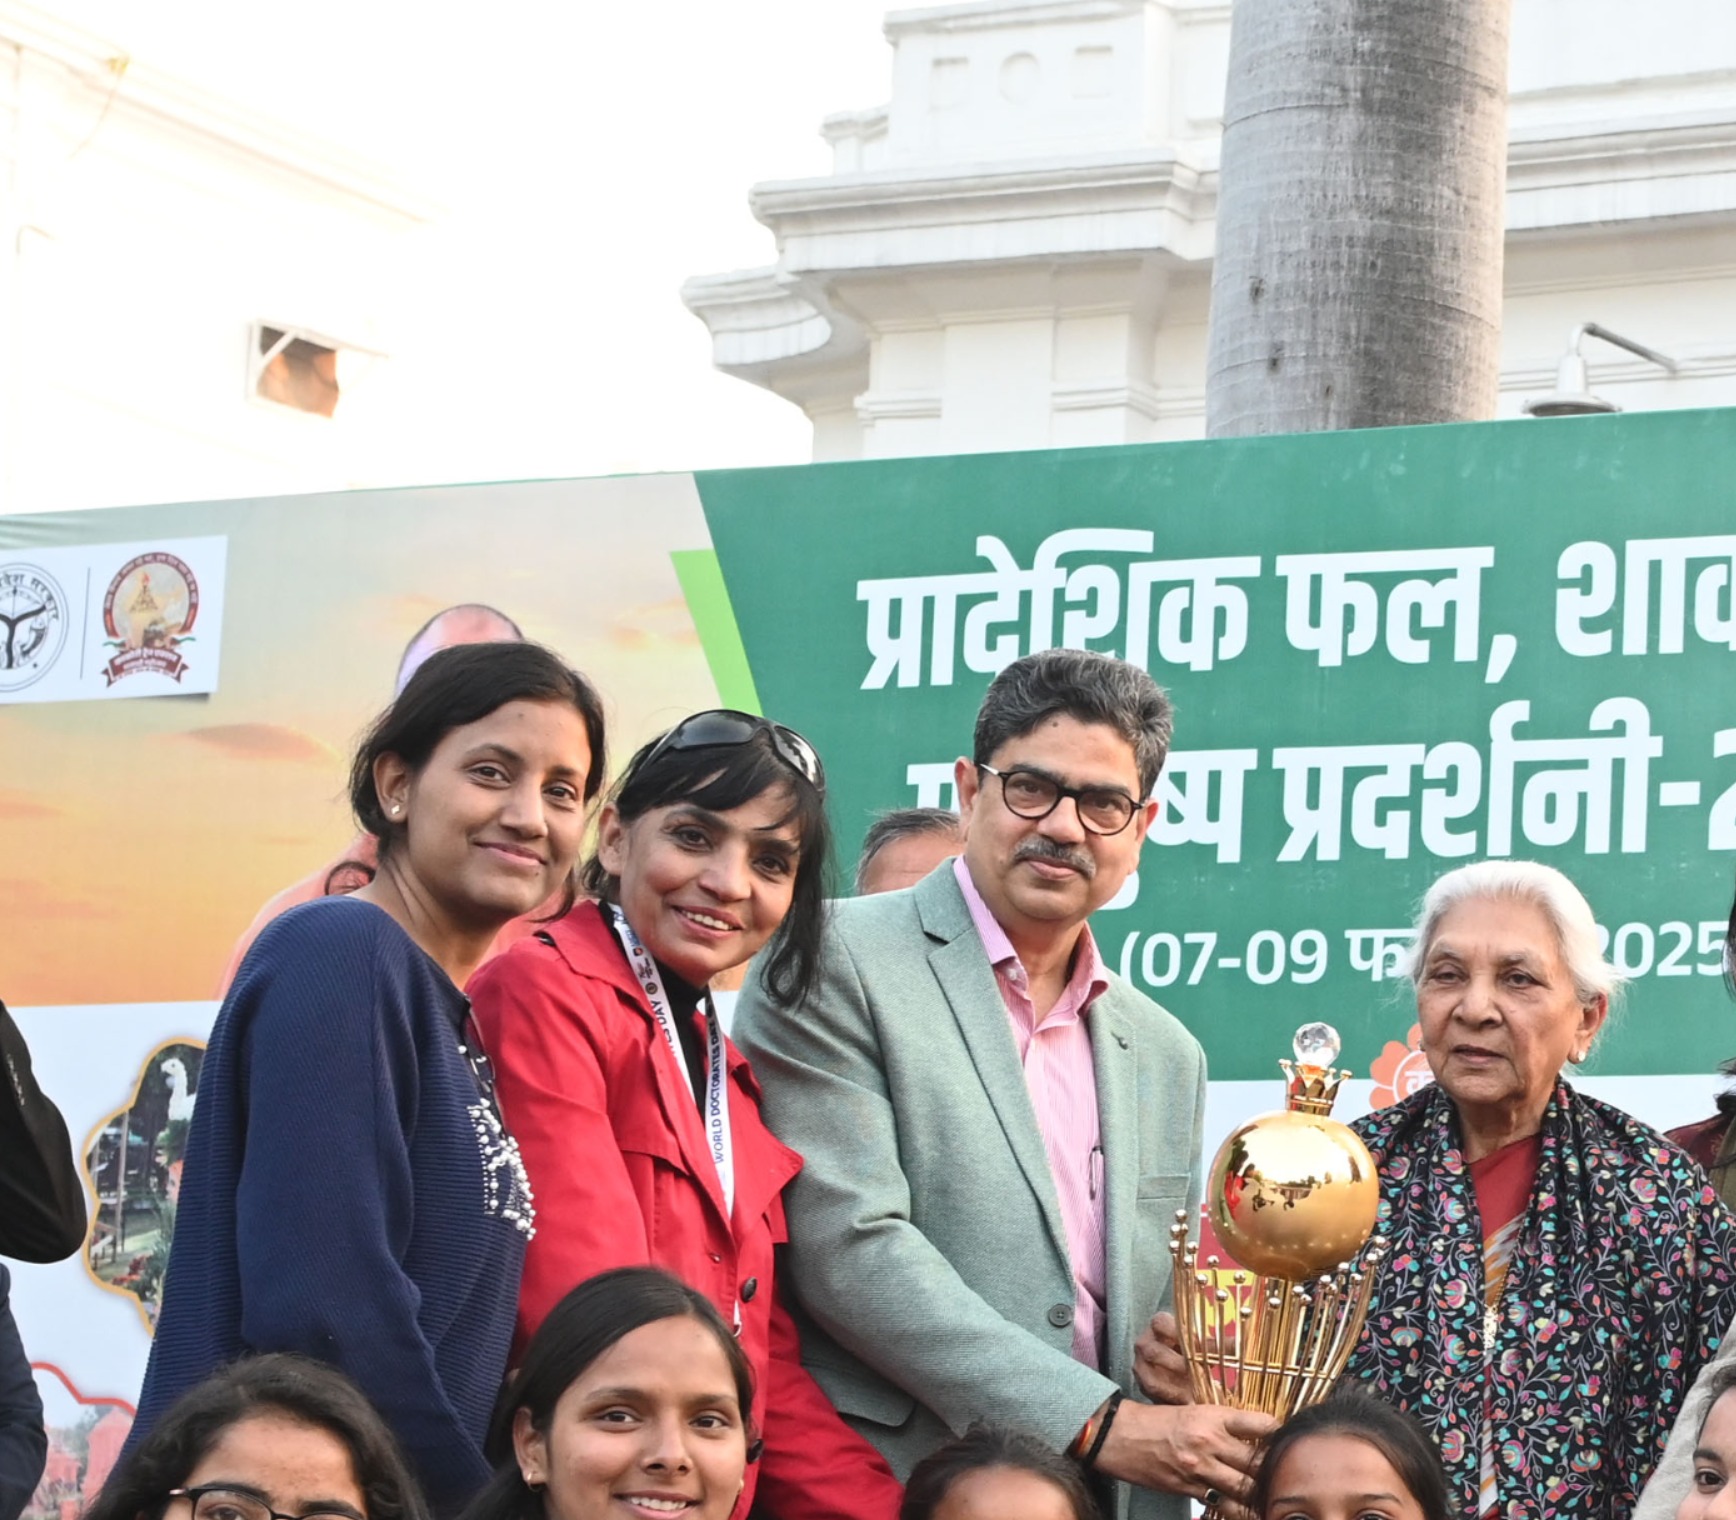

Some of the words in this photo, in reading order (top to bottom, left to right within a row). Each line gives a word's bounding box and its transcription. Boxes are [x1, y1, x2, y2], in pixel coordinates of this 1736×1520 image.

[857, 528, 1261, 690] प्रादेशिक
[1275, 546, 1518, 684] फल,
[1119, 929, 1329, 988] (07-09
[709, 1046, 721, 1116] DOCTORATES
[710, 1118, 725, 1163] WORLD
